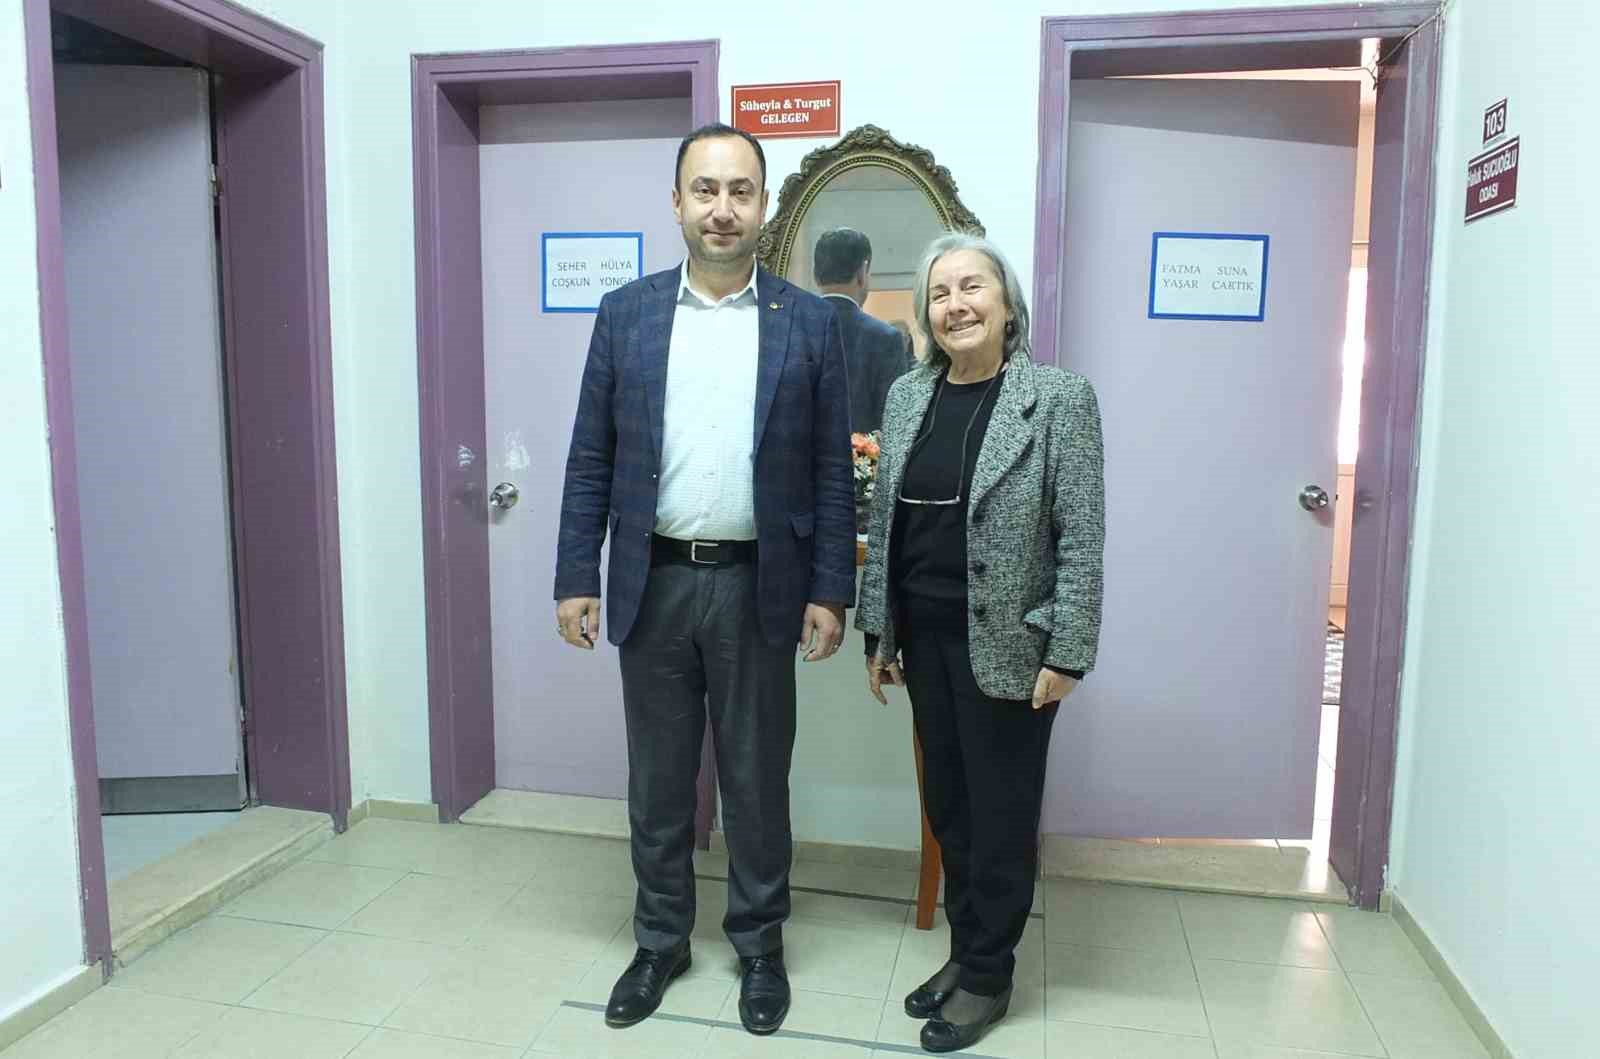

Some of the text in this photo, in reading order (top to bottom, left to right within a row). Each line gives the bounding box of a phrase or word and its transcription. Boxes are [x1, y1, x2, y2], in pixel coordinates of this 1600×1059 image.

[740, 97, 832, 112] Süheyla & Turgut
[761, 112, 809, 124] GELEGEN
[1486, 107, 1504, 138] 103
[1480, 182, 1498, 203] ODASI
[557, 261, 587, 271] SEHER
[600, 258, 632, 270] HÜLYA
[1161, 264, 1201, 275] FATMA
[1216, 265, 1248, 277] SUNA
